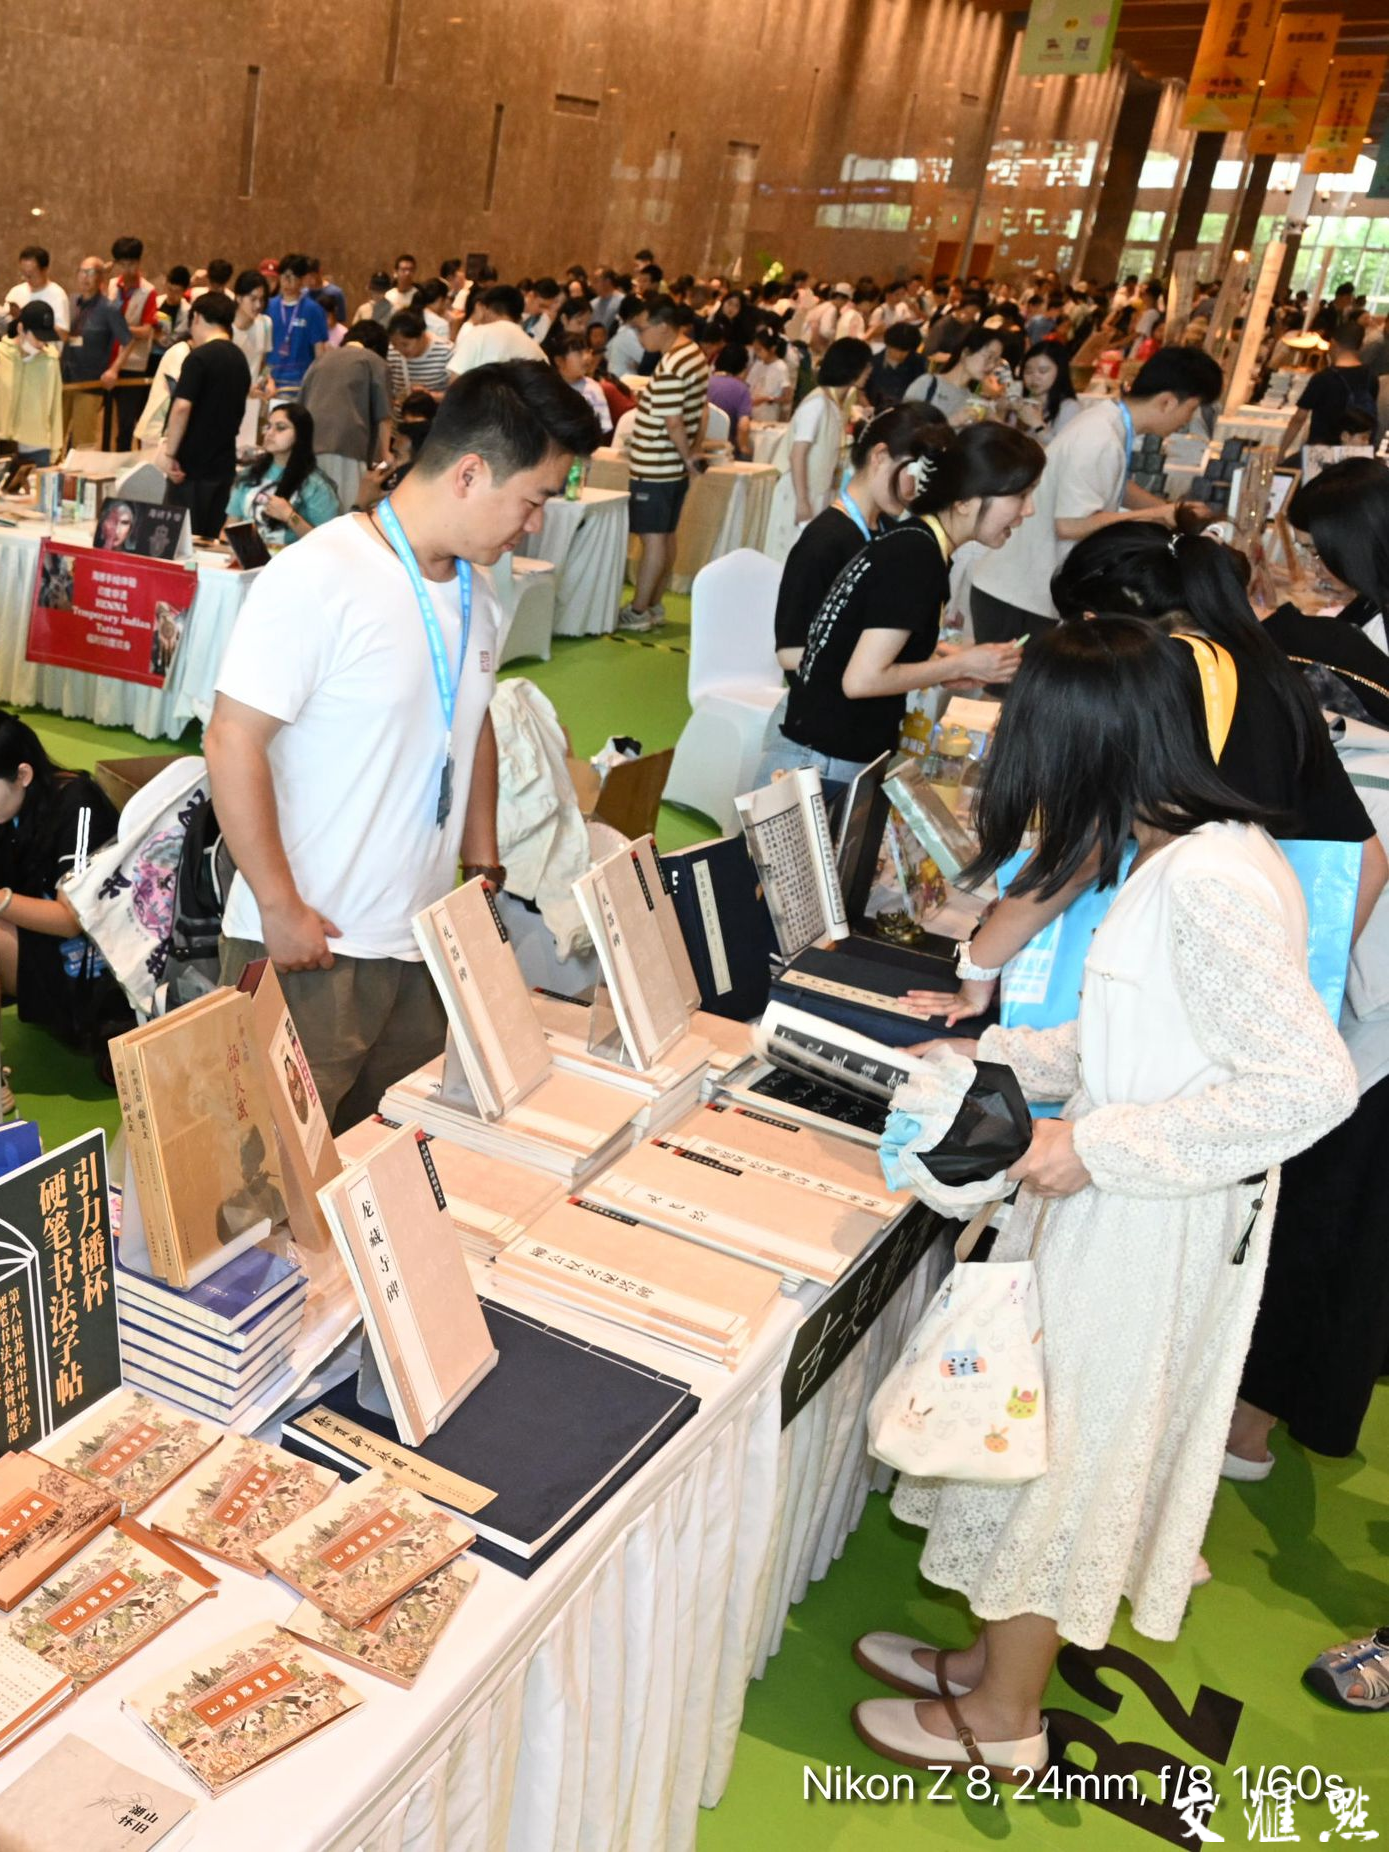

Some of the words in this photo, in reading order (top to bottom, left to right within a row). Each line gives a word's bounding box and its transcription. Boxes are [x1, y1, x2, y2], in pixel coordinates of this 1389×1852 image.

[72, 605, 120, 624] Temporary
[121, 615, 151, 630] Indian
[72, 1151, 109, 1314] 引力播杯
[38, 1167, 84, 1408] 硬笔书法字帖
[8, 1286, 32, 1434] 第八届苏州市中小学
[118, 1815, 150, 1834] 怀旧
[128, 1804, 160, 1824] 湖山
